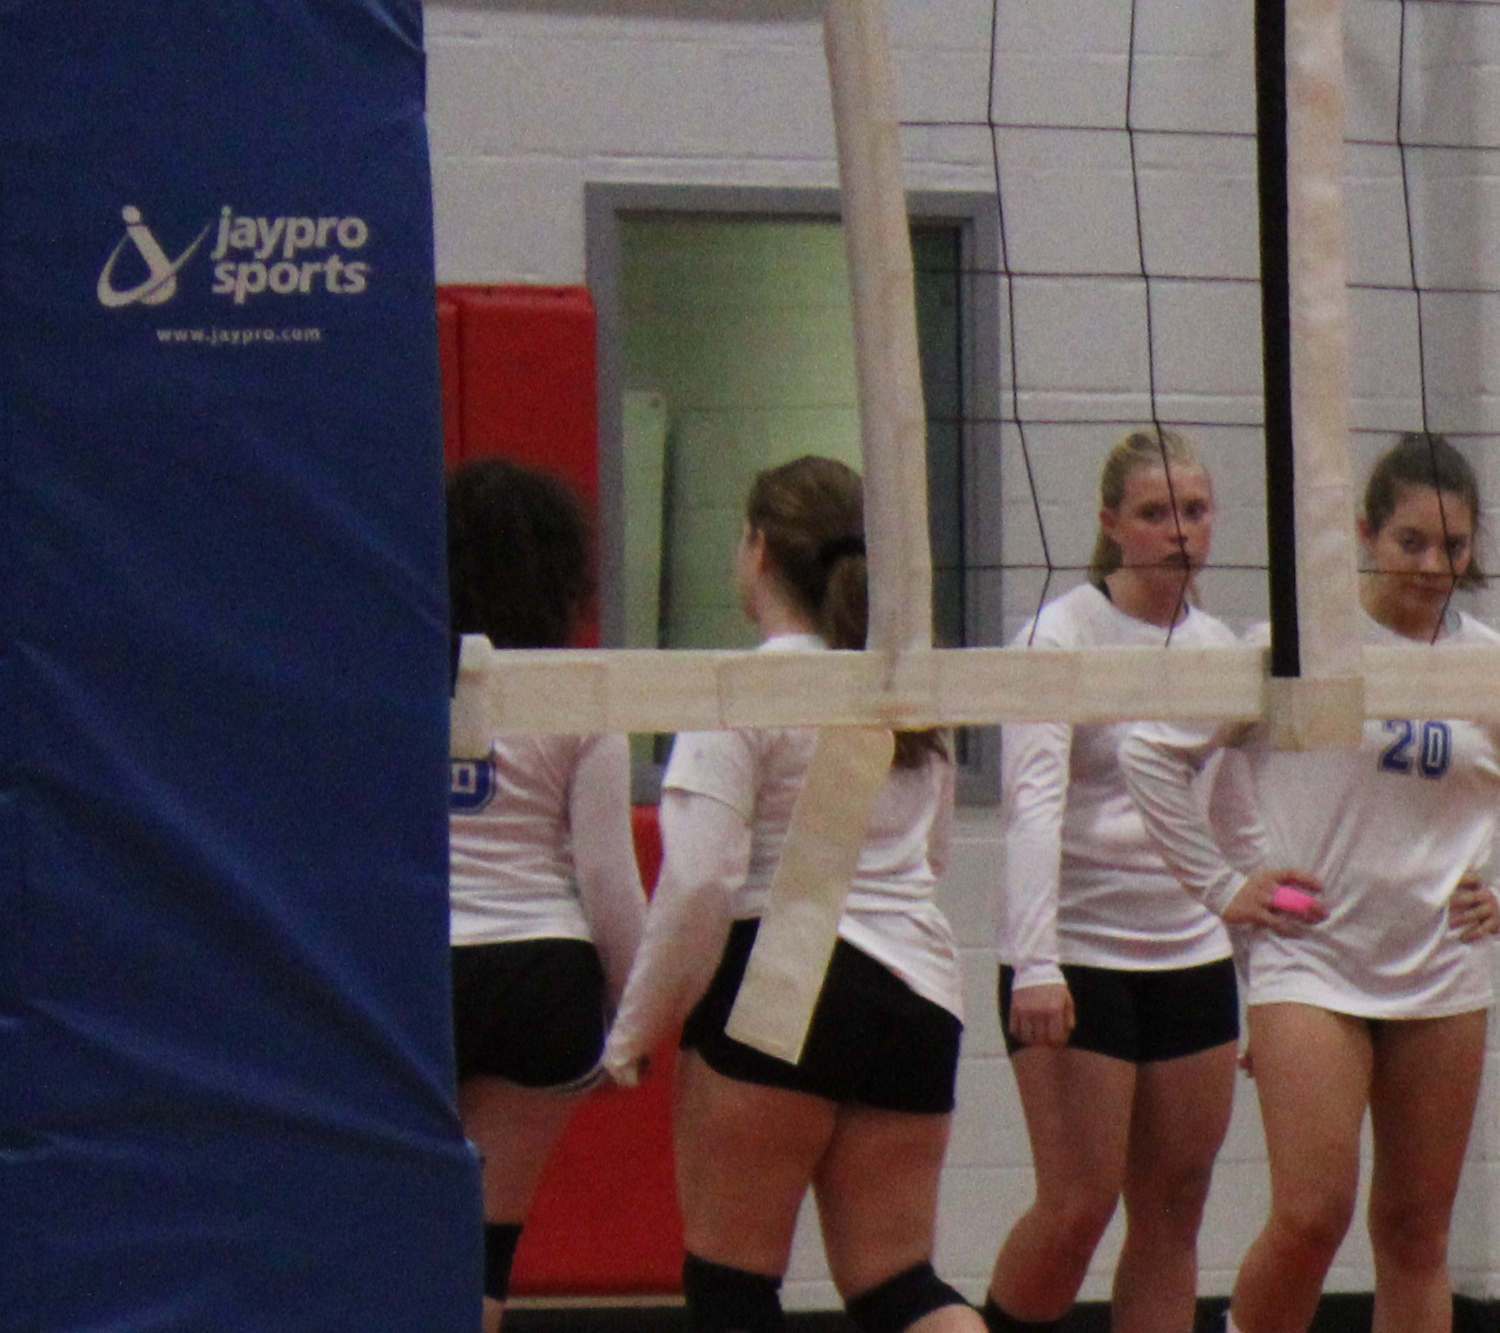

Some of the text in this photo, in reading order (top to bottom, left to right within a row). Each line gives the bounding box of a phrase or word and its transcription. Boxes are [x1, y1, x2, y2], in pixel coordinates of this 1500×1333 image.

[210, 205, 370, 260] jaypro
[210, 254, 371, 305] sports
[155, 327, 323, 346] www.jaypro.com
[1377, 719, 1452, 781] 20
